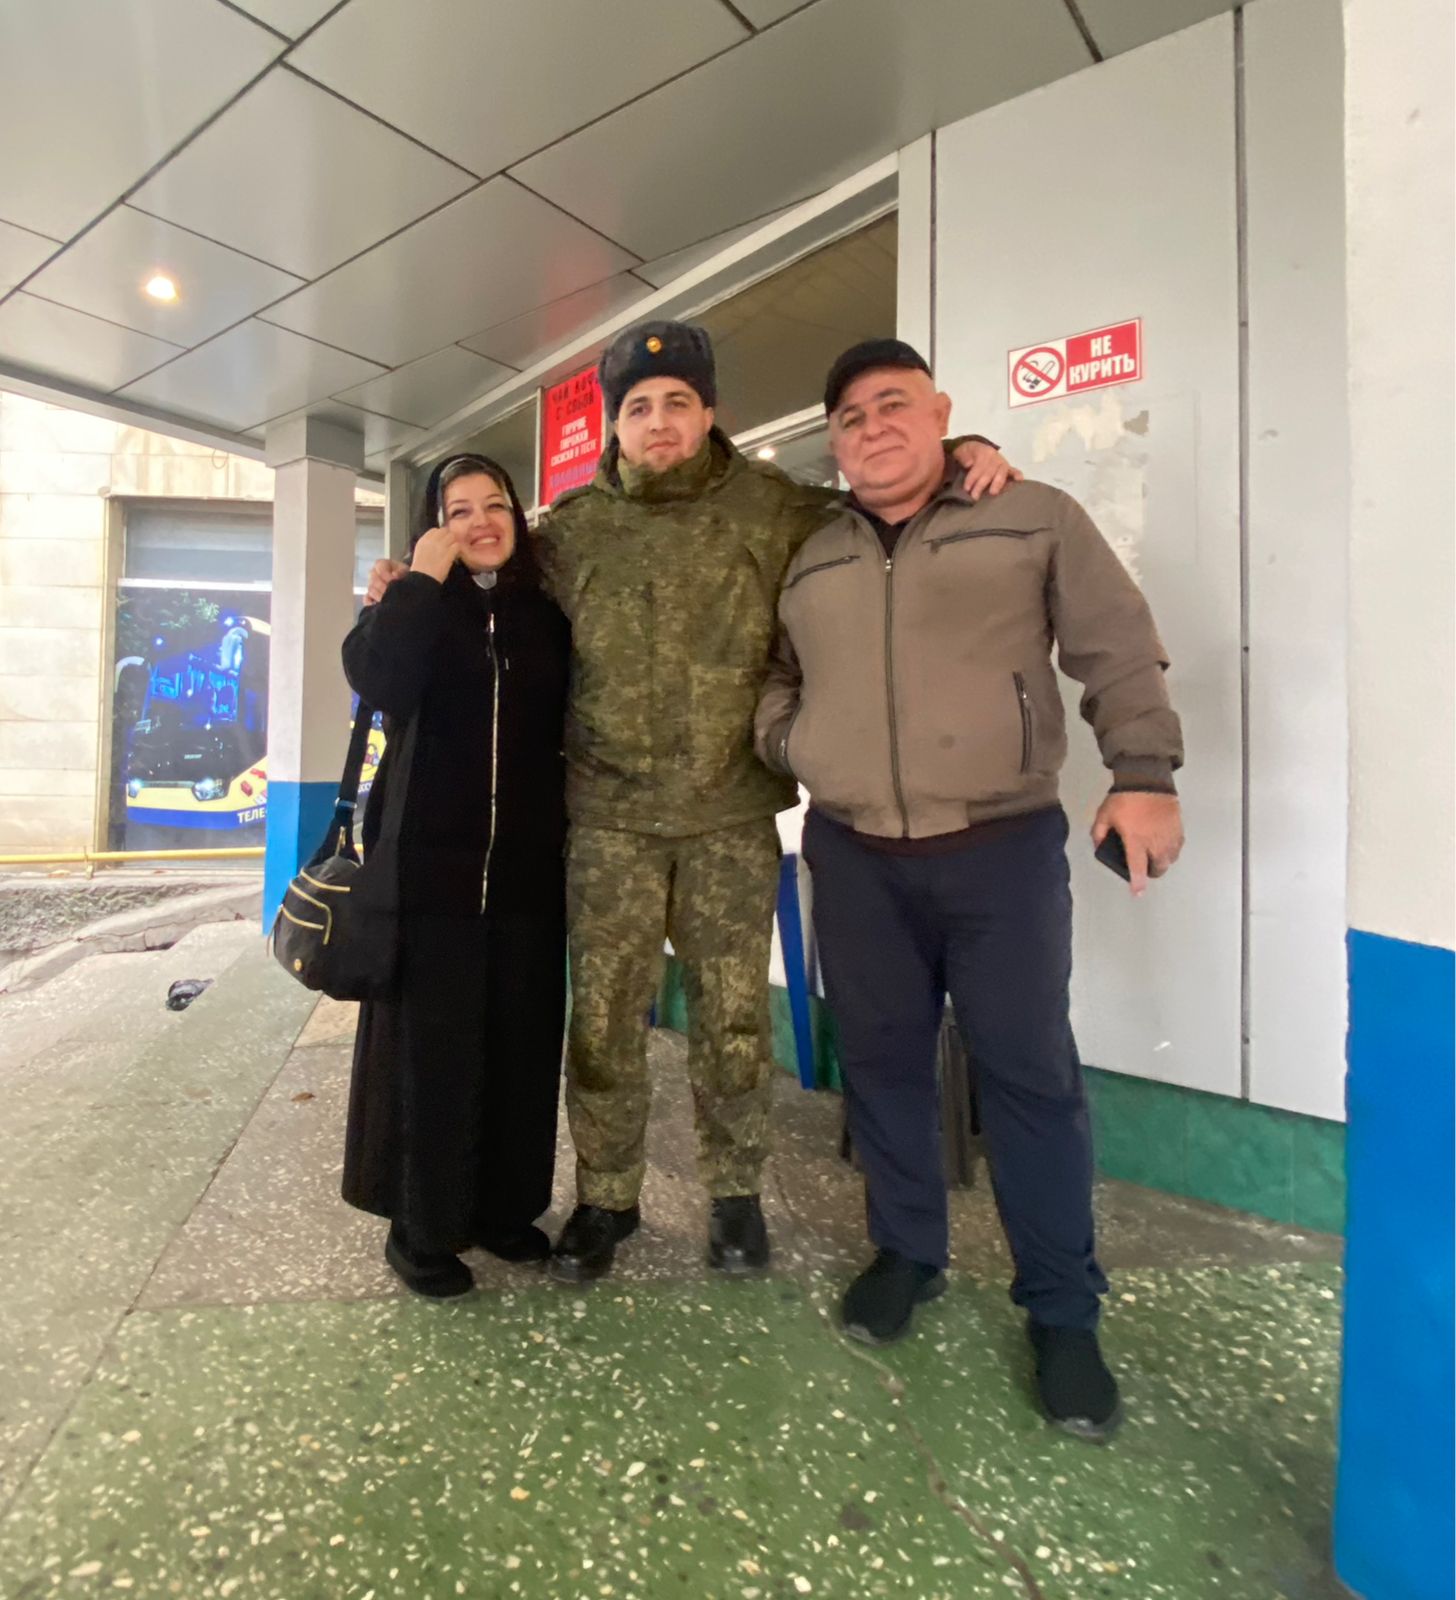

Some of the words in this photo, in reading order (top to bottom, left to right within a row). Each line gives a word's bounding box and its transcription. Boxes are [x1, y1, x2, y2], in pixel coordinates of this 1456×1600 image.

[1091, 335, 1112, 358] НЕ
[1069, 353, 1135, 385] КУРИТЬ
[237, 807, 267, 824] ТЕЛЕ
